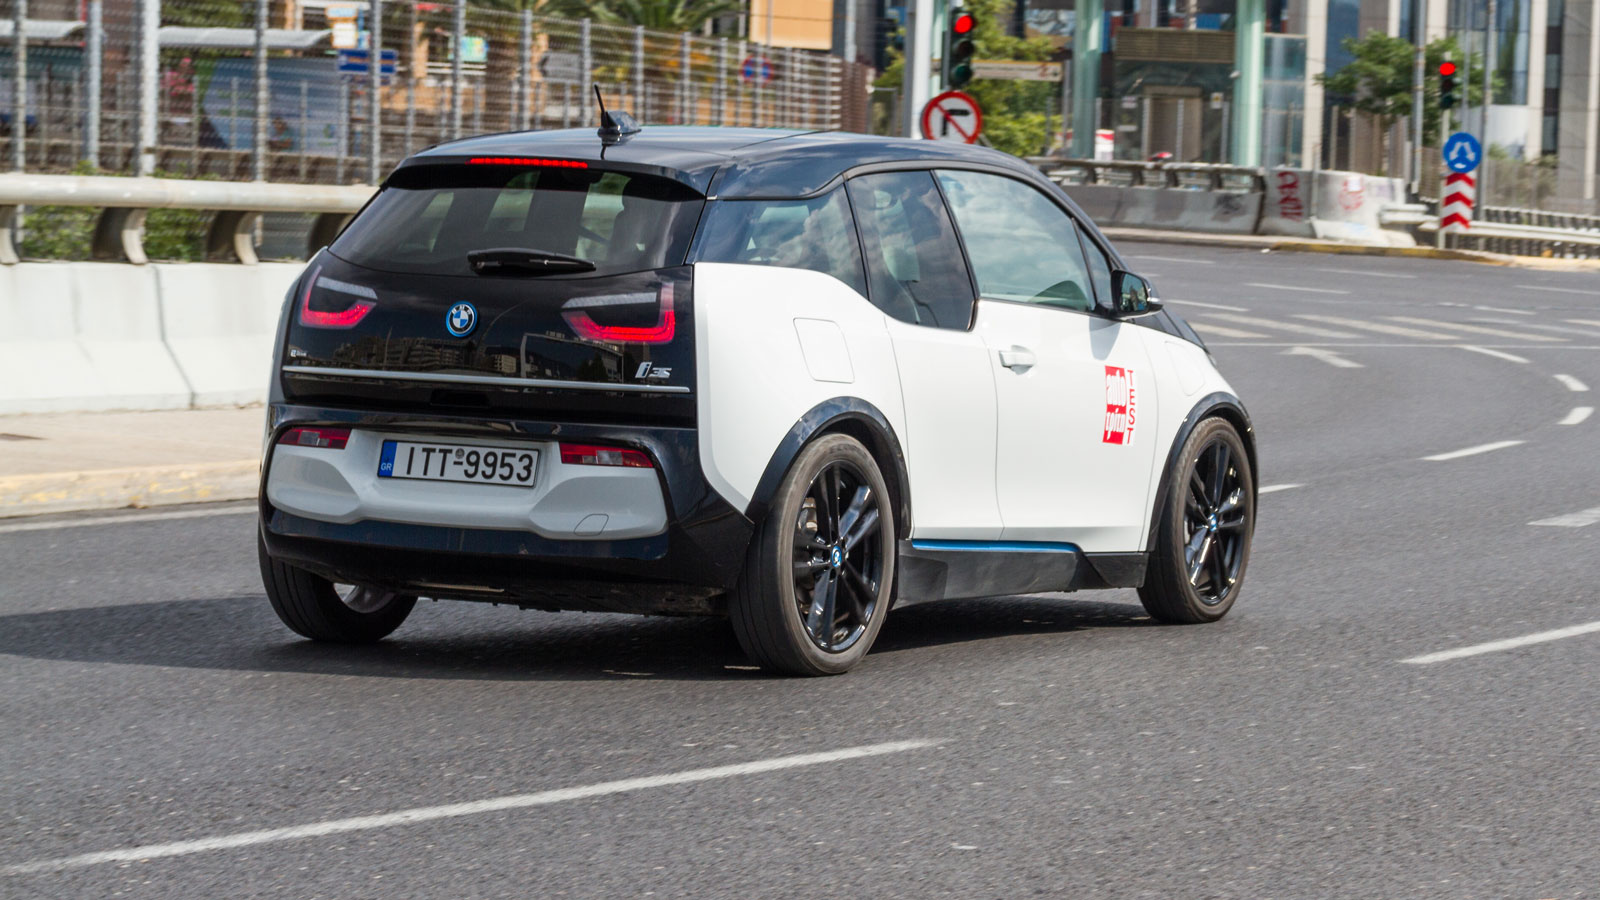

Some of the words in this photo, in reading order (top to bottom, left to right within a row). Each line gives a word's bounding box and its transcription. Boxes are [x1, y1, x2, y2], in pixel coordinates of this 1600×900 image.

[1127, 369, 1136, 445] TEST
[380, 462, 392, 471] GR
[406, 446, 534, 482] ITT-9953
